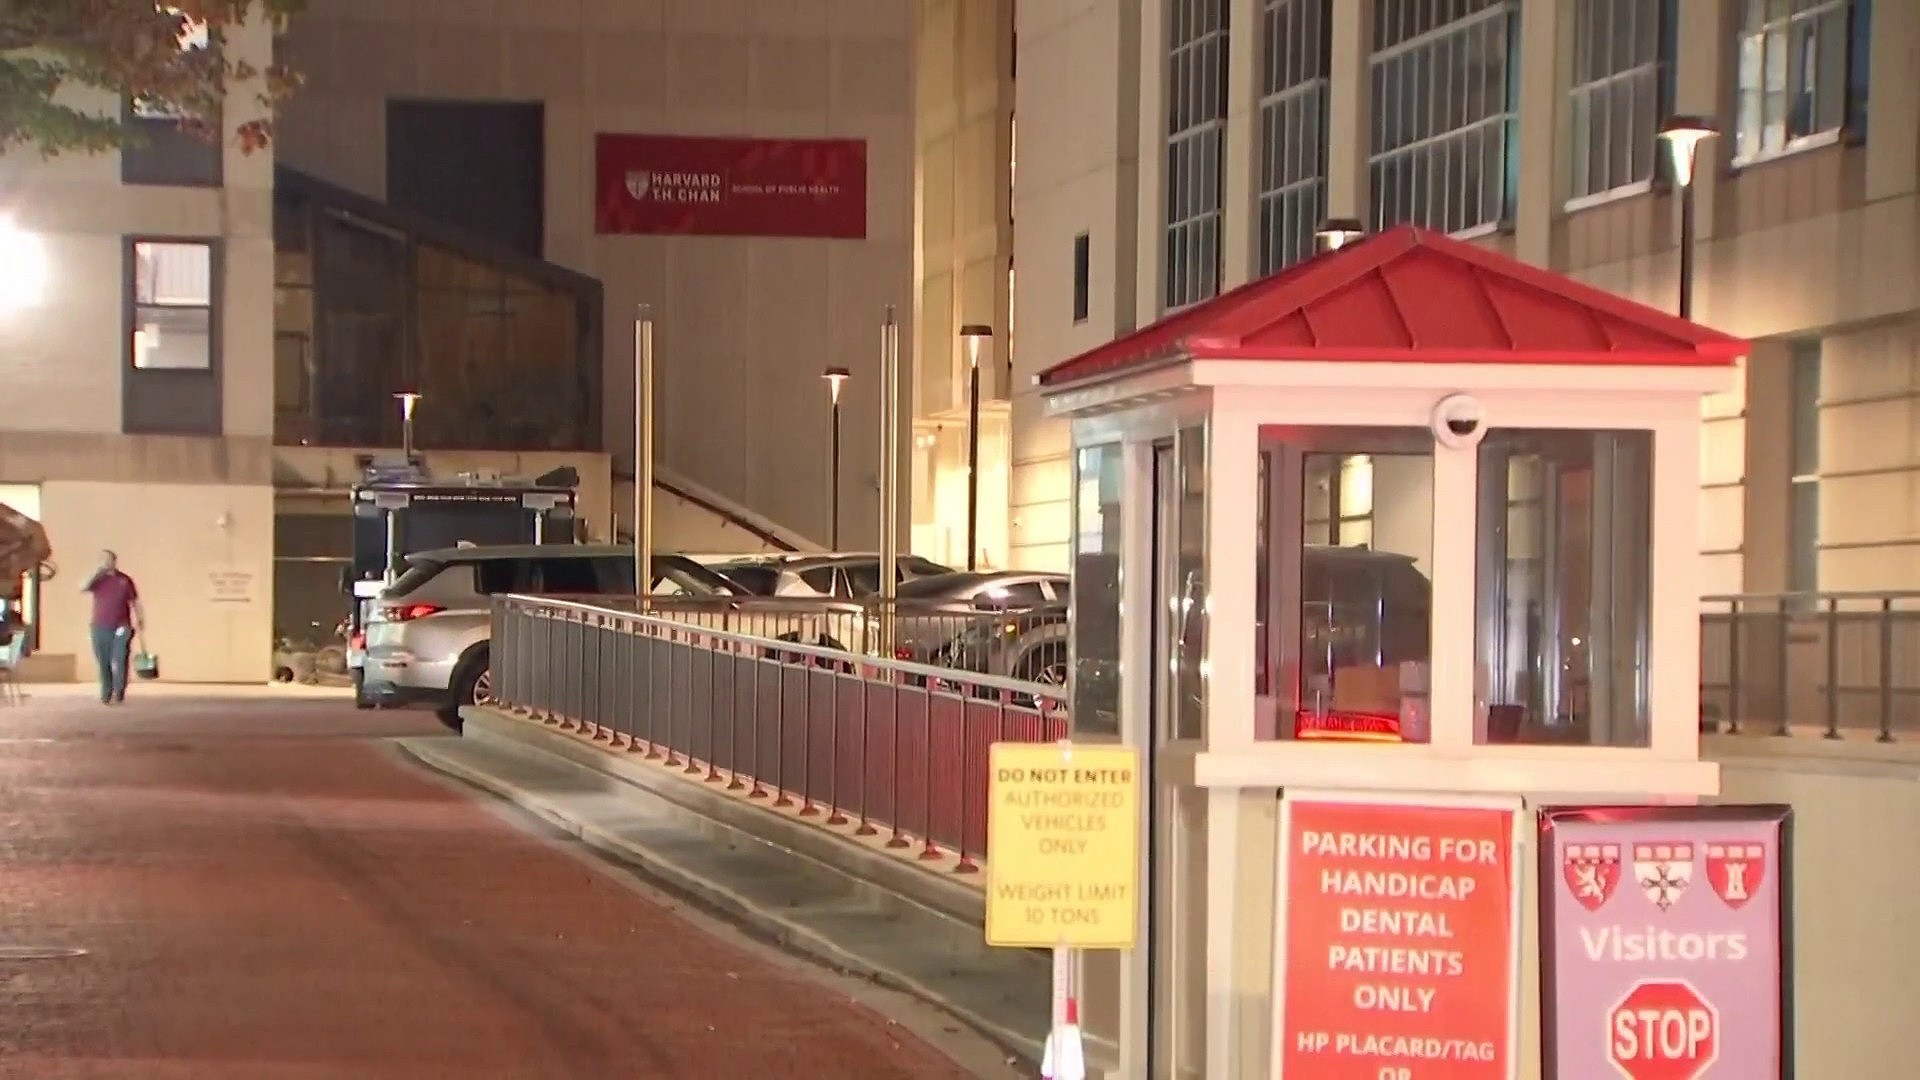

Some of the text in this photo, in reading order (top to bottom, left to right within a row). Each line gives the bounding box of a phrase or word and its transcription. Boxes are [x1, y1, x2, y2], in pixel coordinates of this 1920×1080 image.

[651, 172, 720, 188] HARVARD
[678, 189, 720, 202] CHAN
[998, 768, 1131, 784] DO NOT ENTER
[1004, 790, 1124, 808] AUTHORIZED
[1020, 814, 1106, 831] VEHICLES
[1039, 838, 1087, 854] ONLY
[1302, 831, 1498, 864] PARKING FOR
[998, 883, 1126, 900] WEIGHT LIMIT
[1320, 868, 1476, 901] HANDICAP
[1026, 907, 1100, 925] 10 TONS
[1340, 908, 1454, 938] DENTAL
[1580, 924, 1748, 961] Visitors
[1328, 945, 1464, 976] PATIENTS
[1354, 984, 1436, 1013] ONLY
[1615, 1009, 1710, 1059] STOP
[1297, 1031, 1495, 1061] HP PLACARD/TAG
